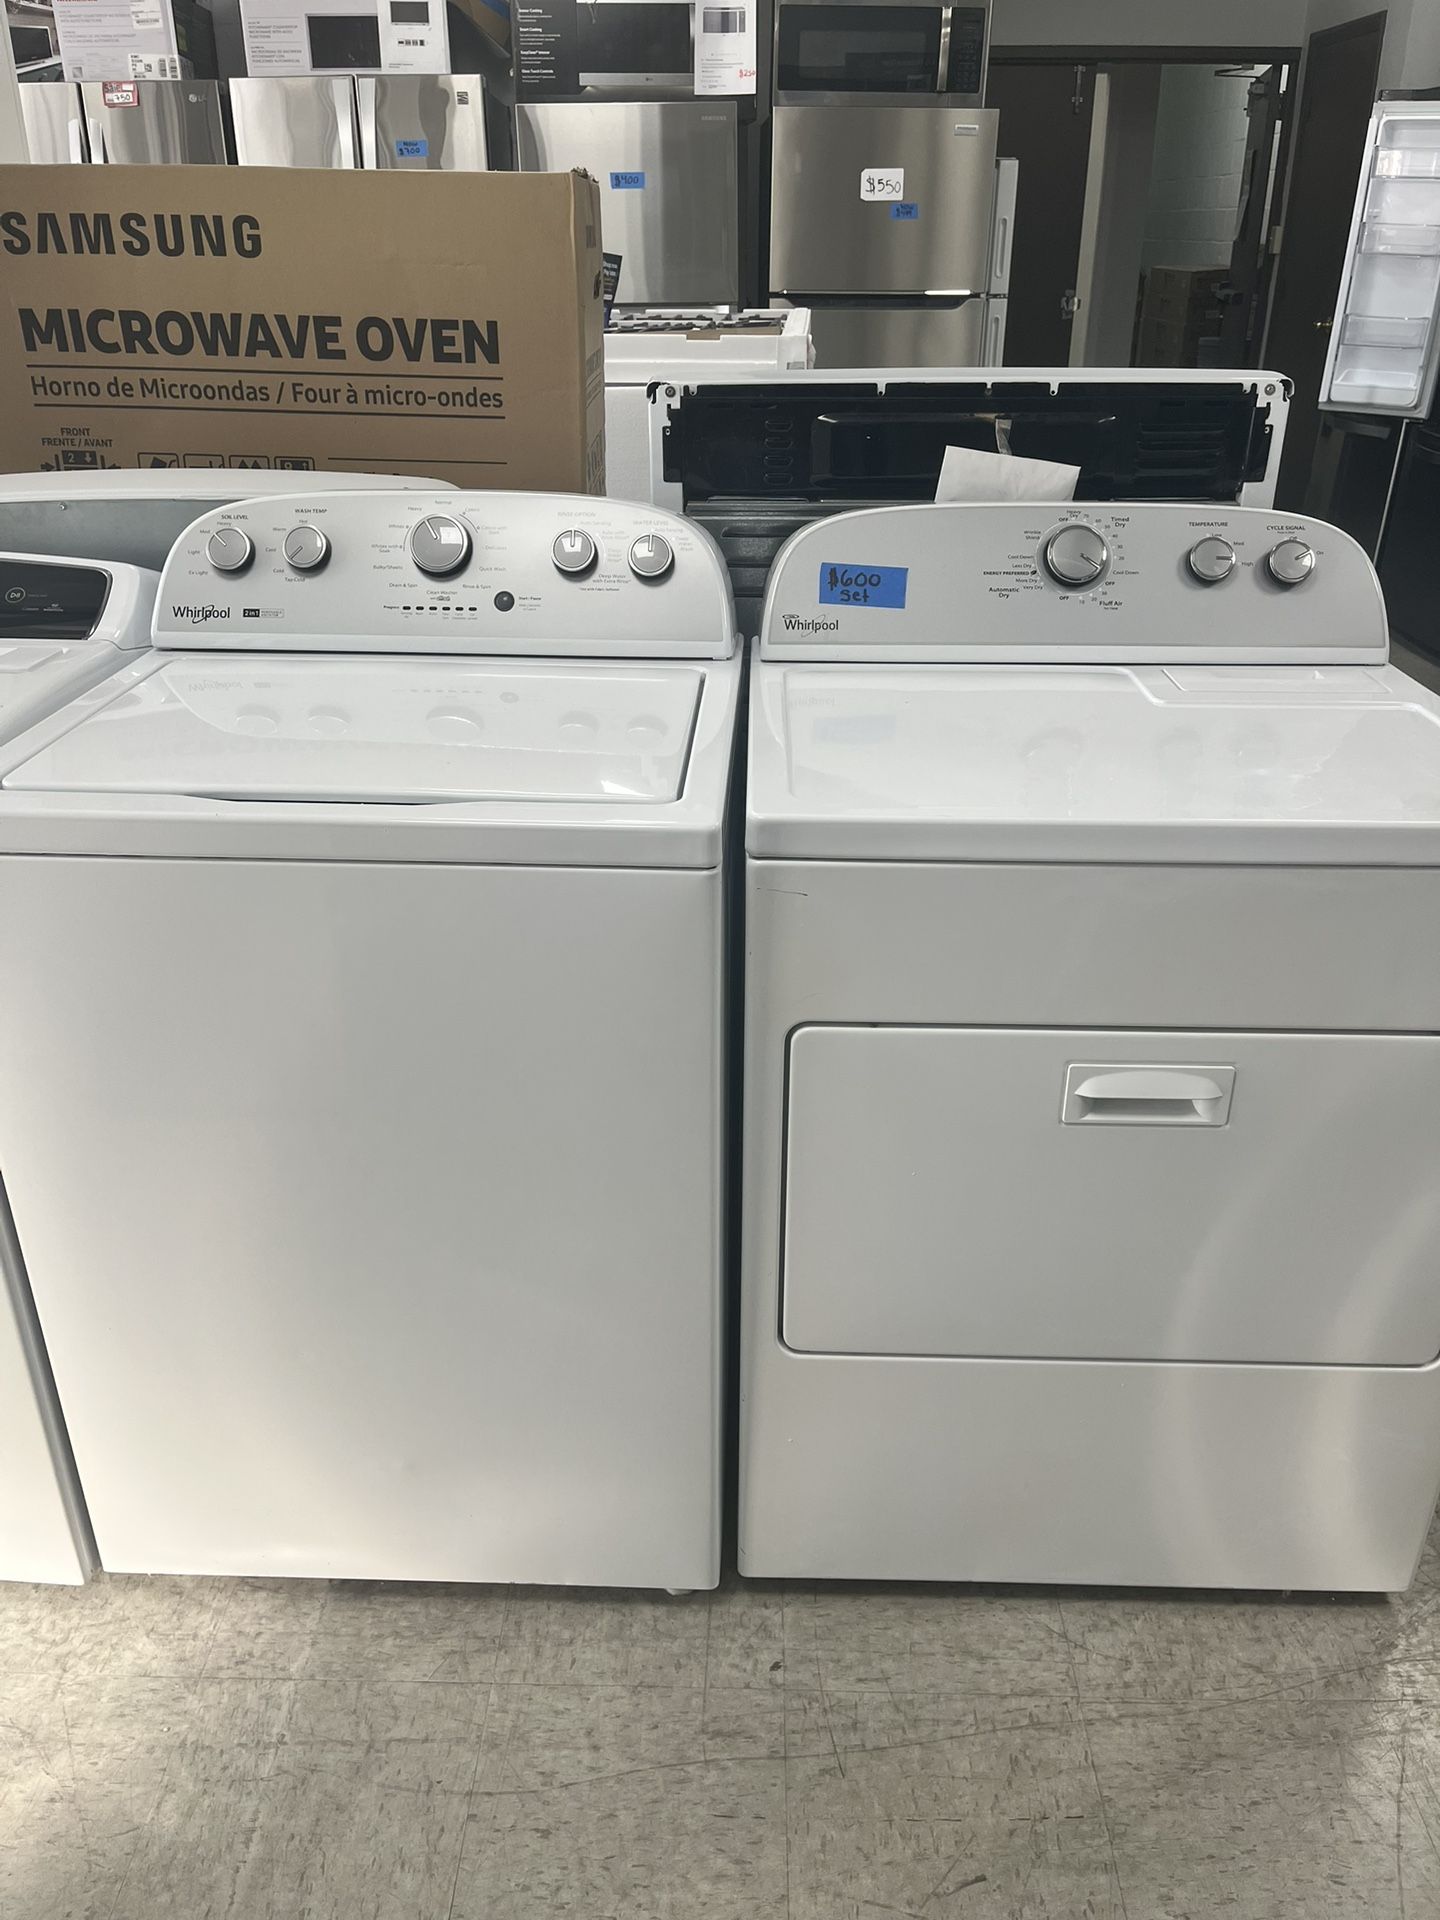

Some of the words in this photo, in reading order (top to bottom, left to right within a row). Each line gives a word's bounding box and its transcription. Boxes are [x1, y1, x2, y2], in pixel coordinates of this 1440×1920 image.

[615, 175, 640, 189] $400
[865, 176, 901, 194] $550
[0, 210, 262, 259] SAMSUNG
[17, 307, 347, 360] MICROWAVE
[355, 315, 500, 365] OVEN
[31, 375, 100, 397] Horno
[106, 376, 134, 398] de
[139, 377, 270, 402] Microondas
[291, 382, 342, 404] Four
[346, 383, 359, 405] à
[365, 385, 504, 409] micro-ondes
[60, 427, 90, 437] FRONT
[41, 437, 77, 447] FRENTE
[83, 438, 113, 448] AVANT
[827, 566, 882, 591] $600
[172, 604, 231, 623] Whirlpool
[783, 617, 839, 635] Whirlpool
